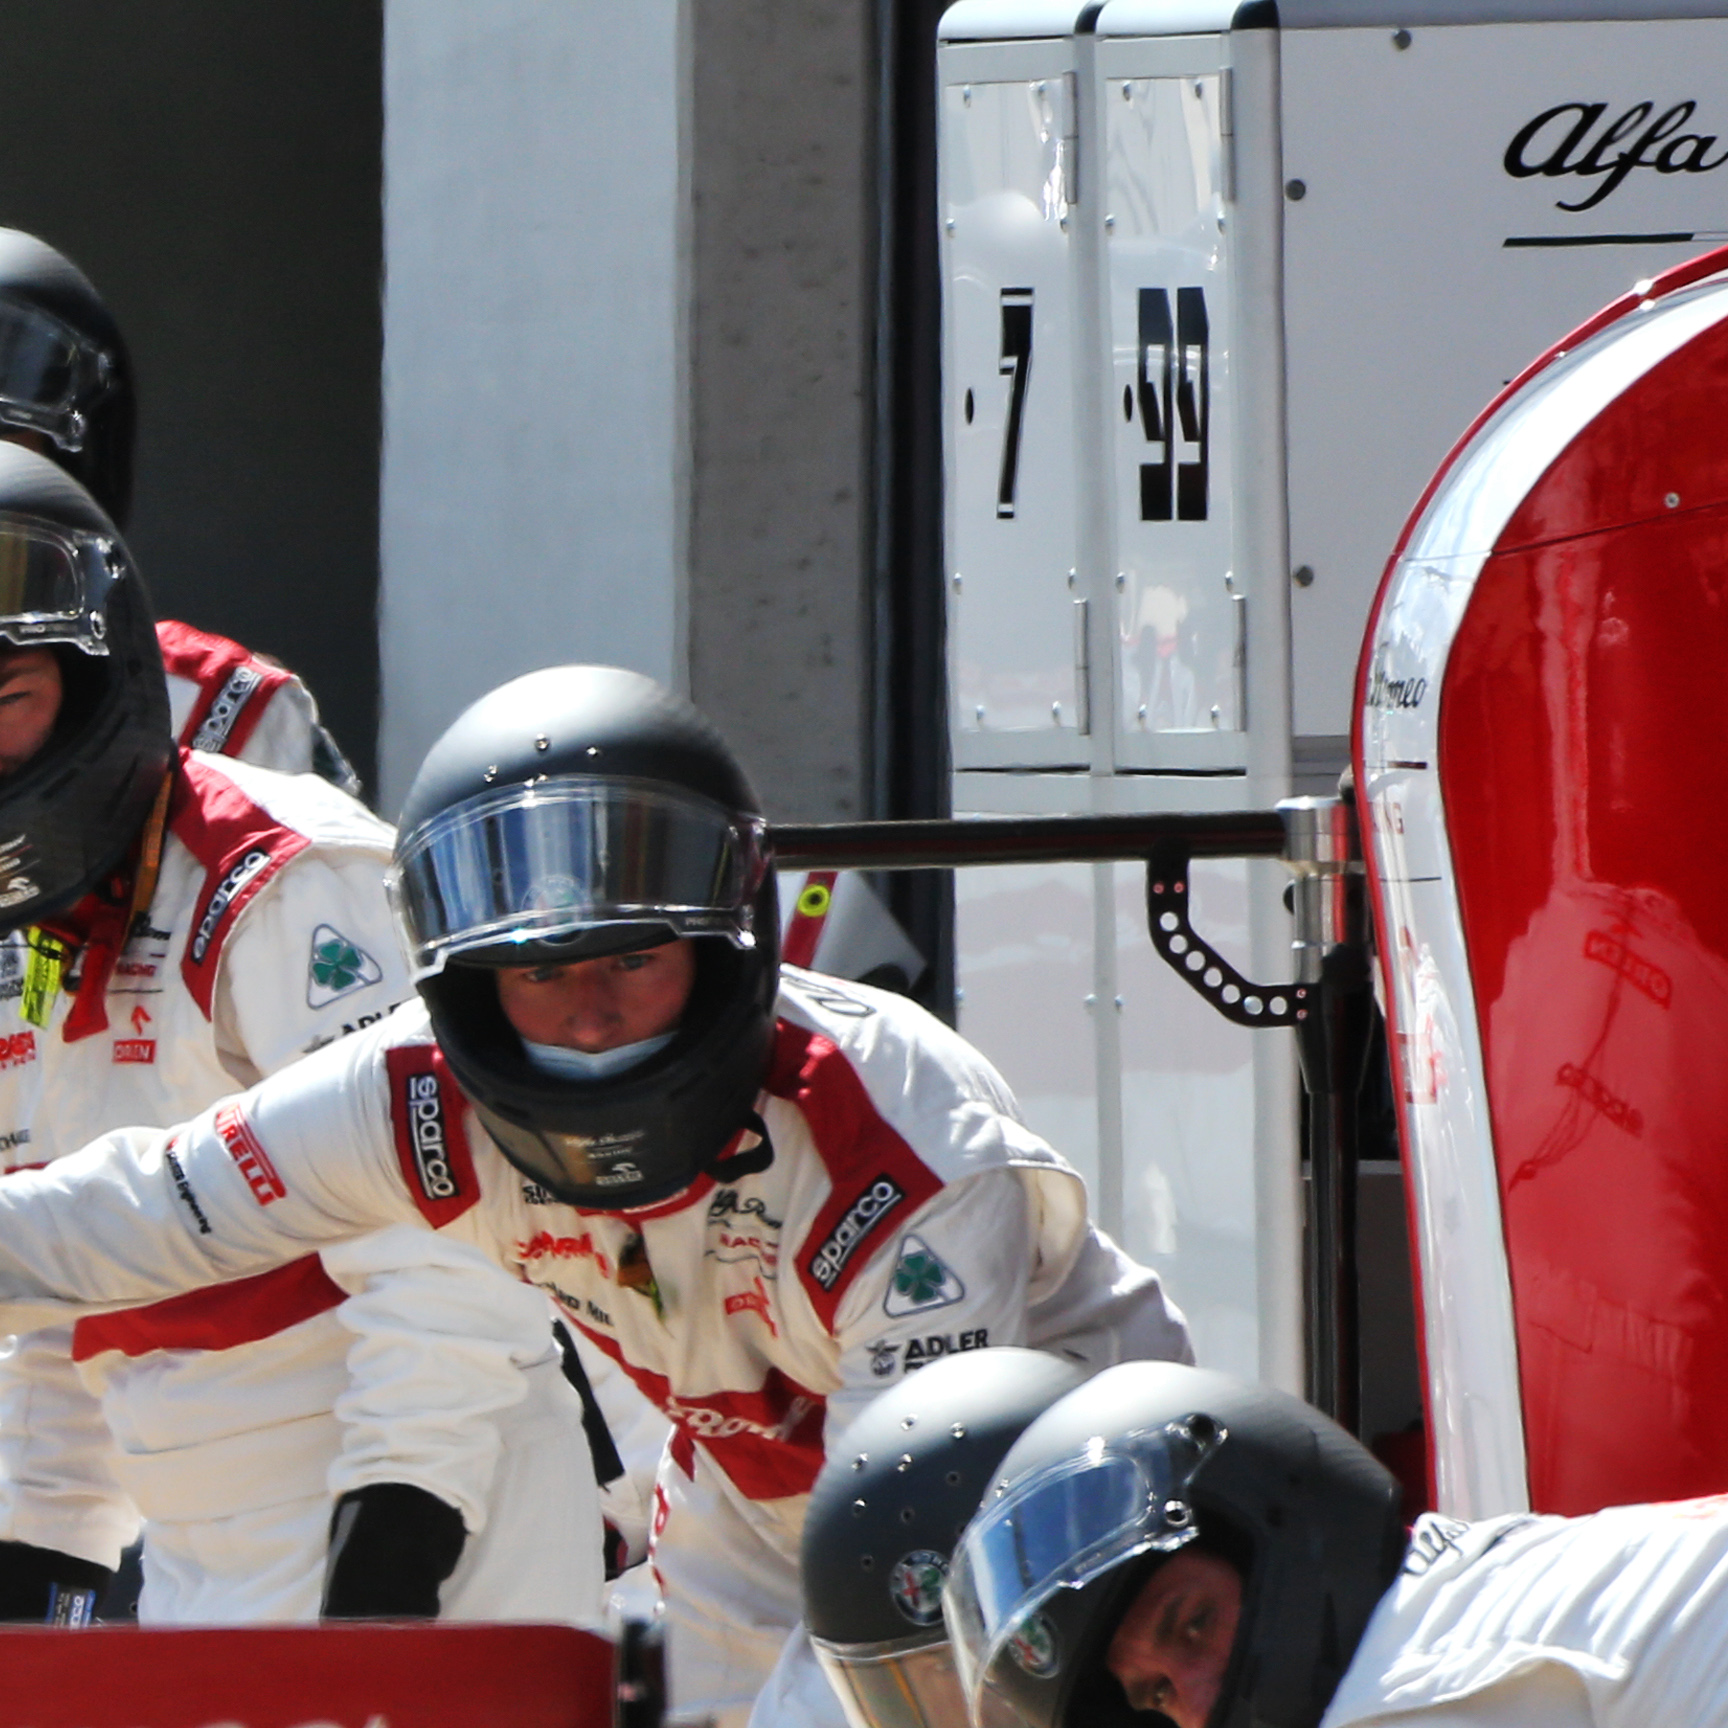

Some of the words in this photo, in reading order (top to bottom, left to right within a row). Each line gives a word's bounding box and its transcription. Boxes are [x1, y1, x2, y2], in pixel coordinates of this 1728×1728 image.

[1502, 101, 1728, 212] Alfa
[997, 287, 1035, 520] 7
[192, 850, 272, 962] sparco
[408, 1074, 458, 1202] sparco
[809, 1180, 902, 1289] sparco
[904, 1328, 990, 1361] ADLER
